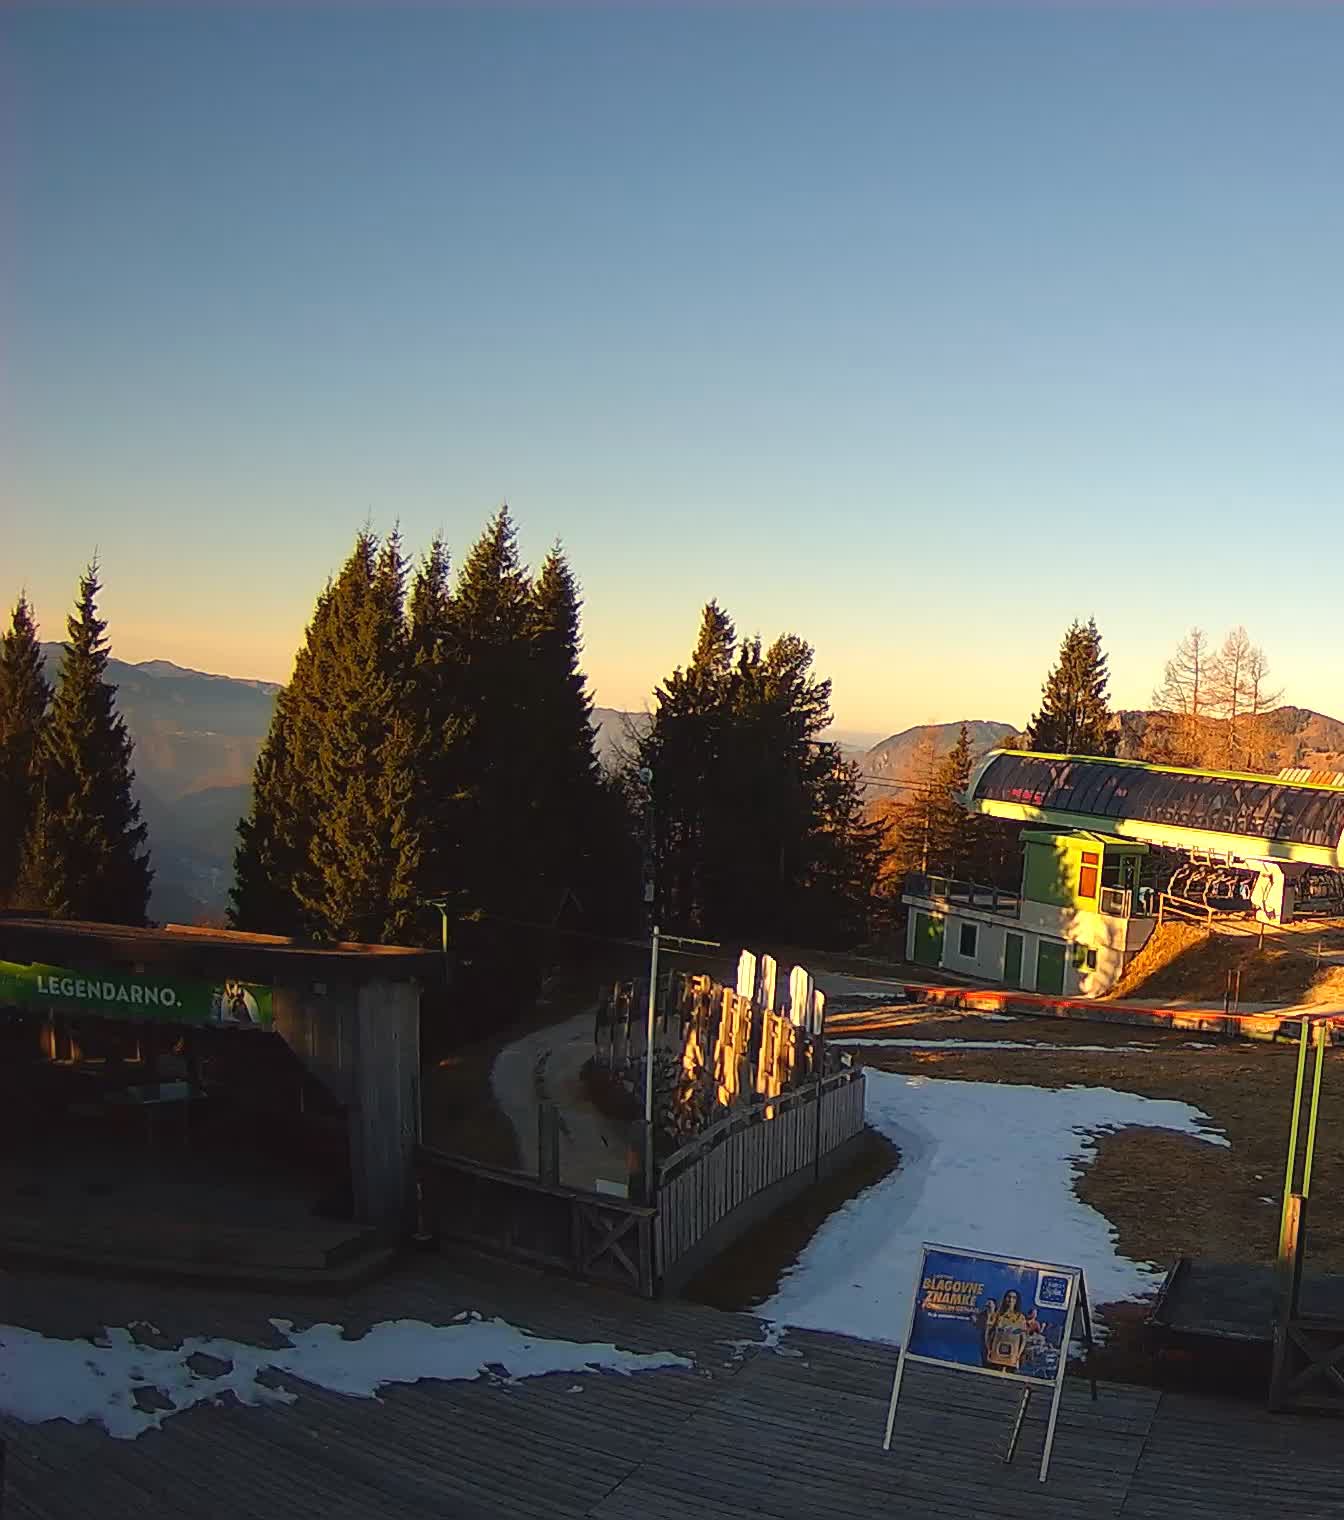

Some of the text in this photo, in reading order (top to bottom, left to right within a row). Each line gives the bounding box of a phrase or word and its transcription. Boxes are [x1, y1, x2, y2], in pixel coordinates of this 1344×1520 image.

[36, 975, 184, 1008] LEGENDARNO.
[922, 1278, 985, 1296] BLAGOVNE
[926, 1290, 977, 1307] ZNAMKE
